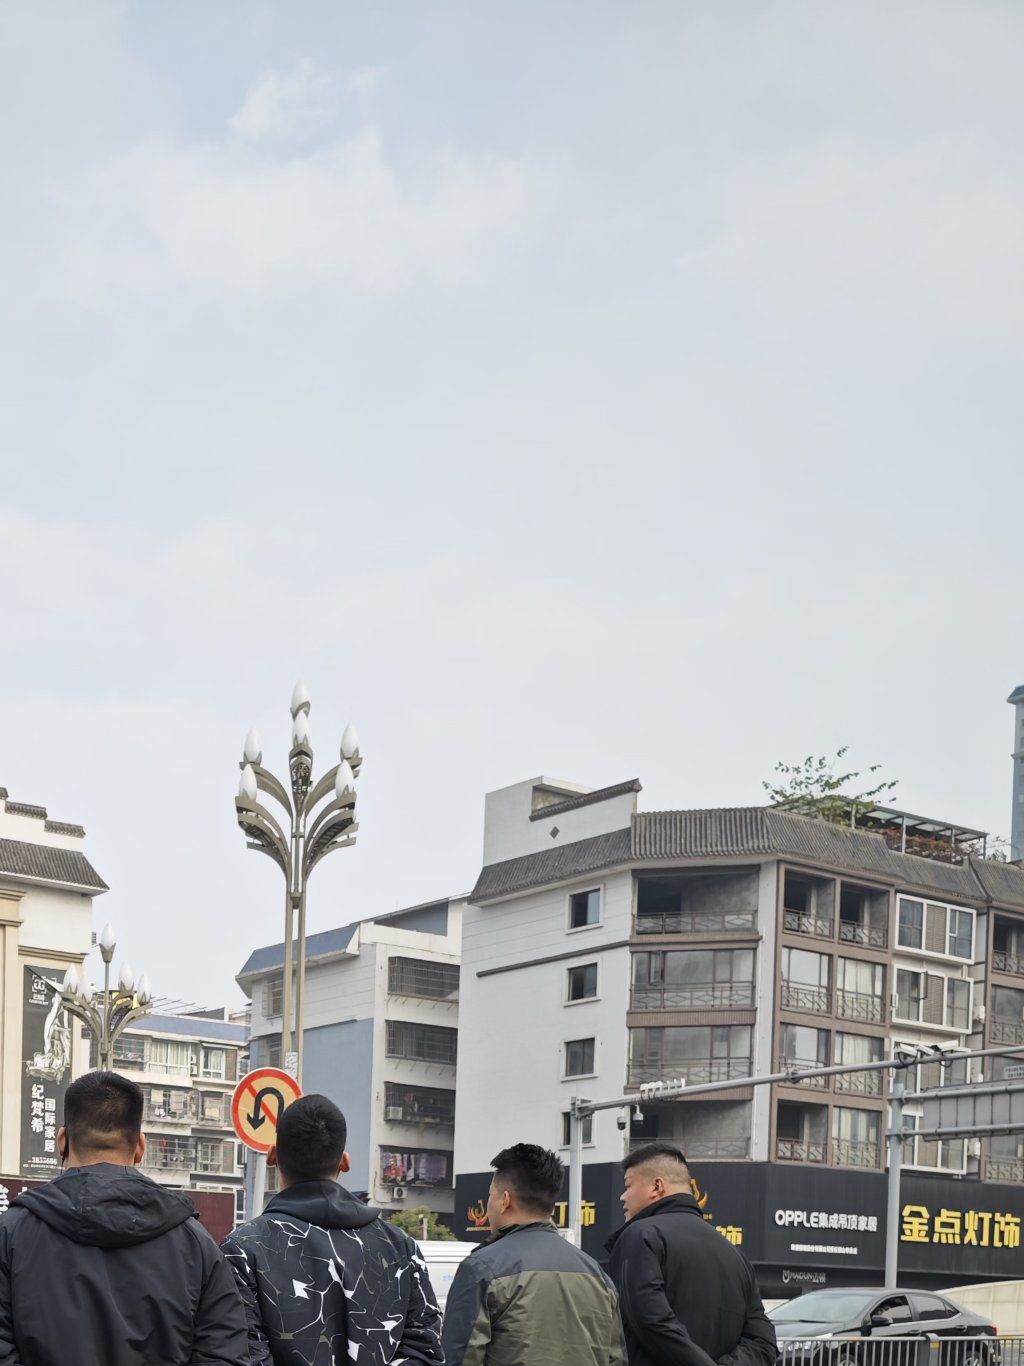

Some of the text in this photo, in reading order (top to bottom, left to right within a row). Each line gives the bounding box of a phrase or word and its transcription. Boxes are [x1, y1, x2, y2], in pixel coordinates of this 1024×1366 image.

[31, 1084, 44, 1133] 纪梵希
[44, 1098, 56, 1153] 国际家居
[900, 1204, 1021, 1248] 金点灯饰
